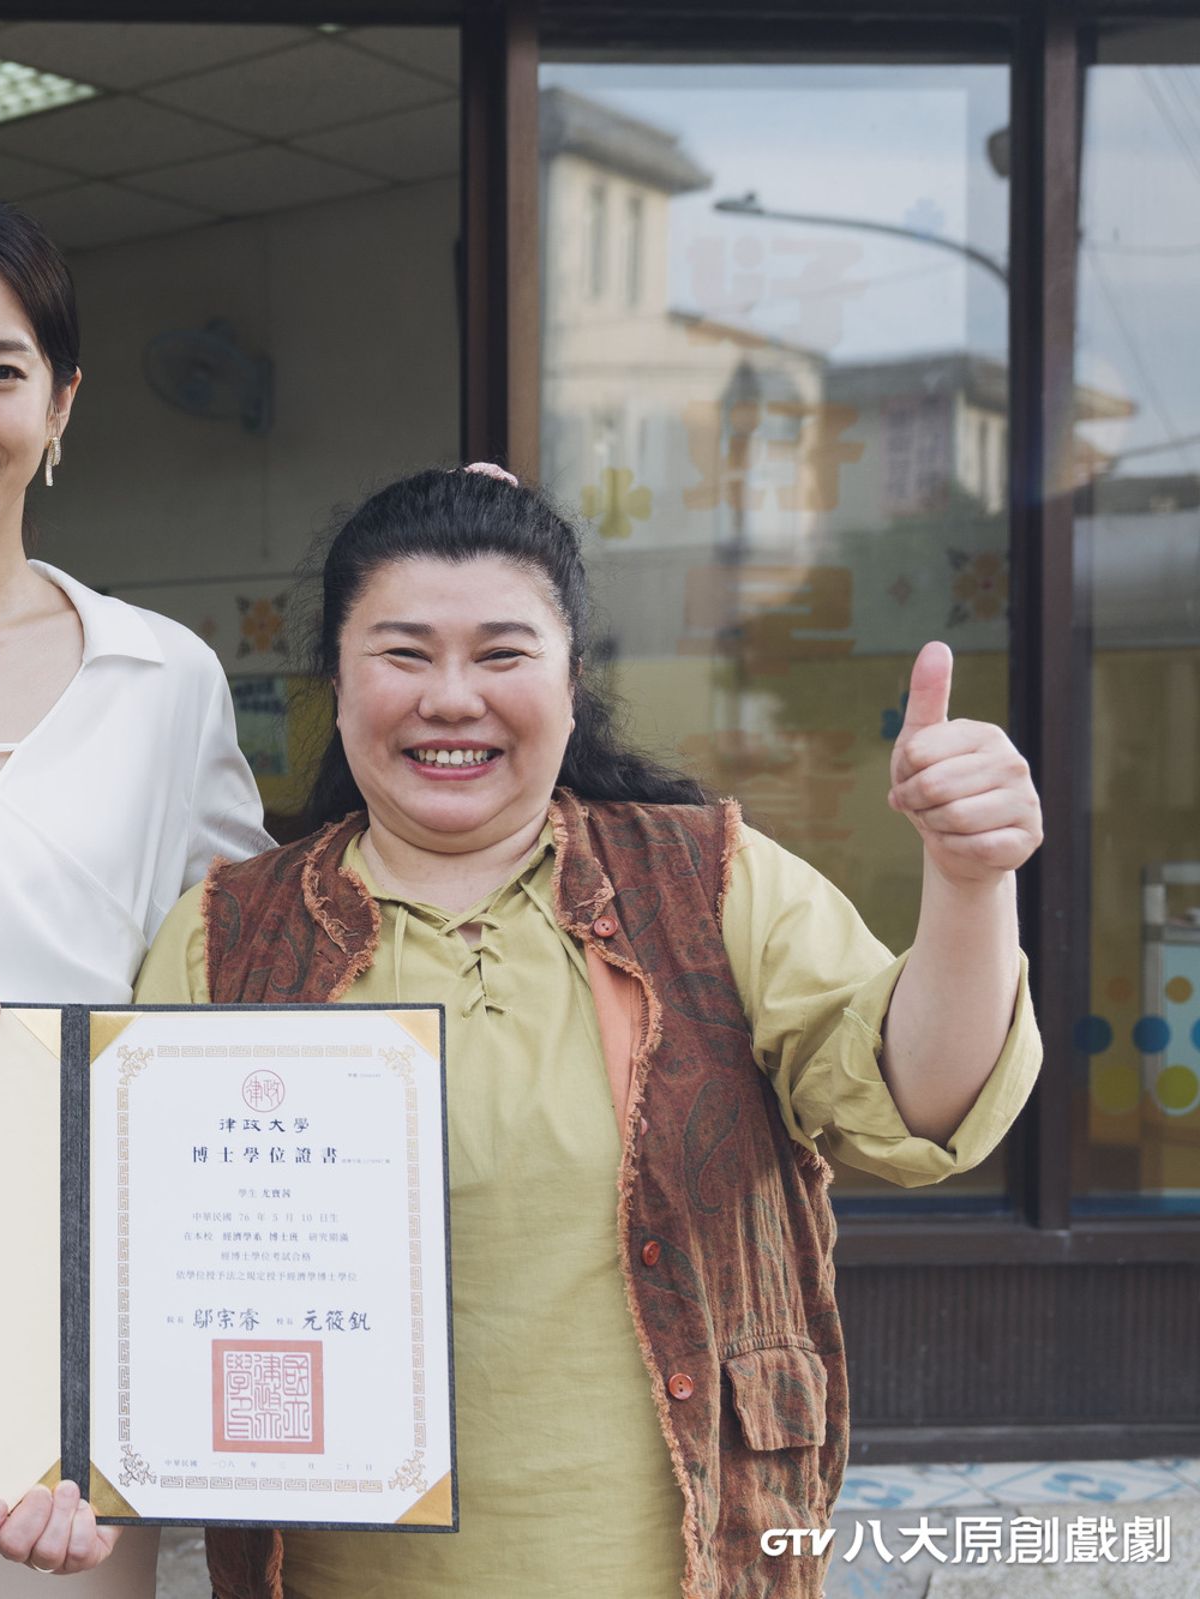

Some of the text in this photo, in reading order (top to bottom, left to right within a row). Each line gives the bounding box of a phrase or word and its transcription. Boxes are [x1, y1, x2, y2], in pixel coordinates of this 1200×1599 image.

[219, 1117, 310, 1134] 律政大學
[192, 1146, 337, 1164] 博士學位證書
